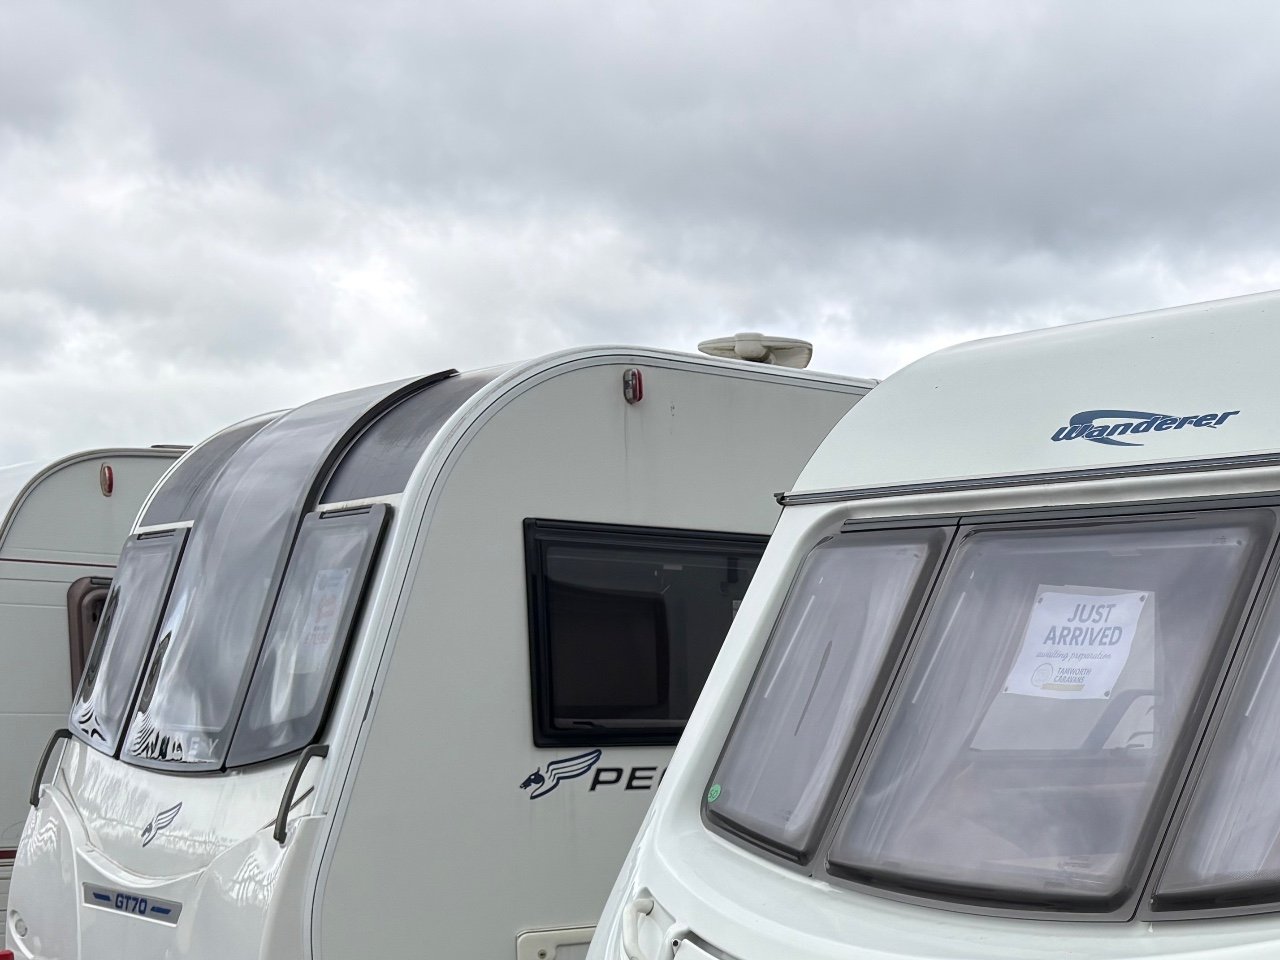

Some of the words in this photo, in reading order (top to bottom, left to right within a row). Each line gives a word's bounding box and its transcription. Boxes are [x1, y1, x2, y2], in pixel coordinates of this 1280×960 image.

[1051, 410, 1240, 441] Wanderer
[1067, 603, 1116, 624] JUST
[1043, 625, 1123, 647] ARRIVED
[1053, 675, 1085, 684] CARAVANS
[1056, 667, 1092, 676] TAMWORTH
[589, 766, 667, 792] PE
[114, 893, 148, 915] GT70
